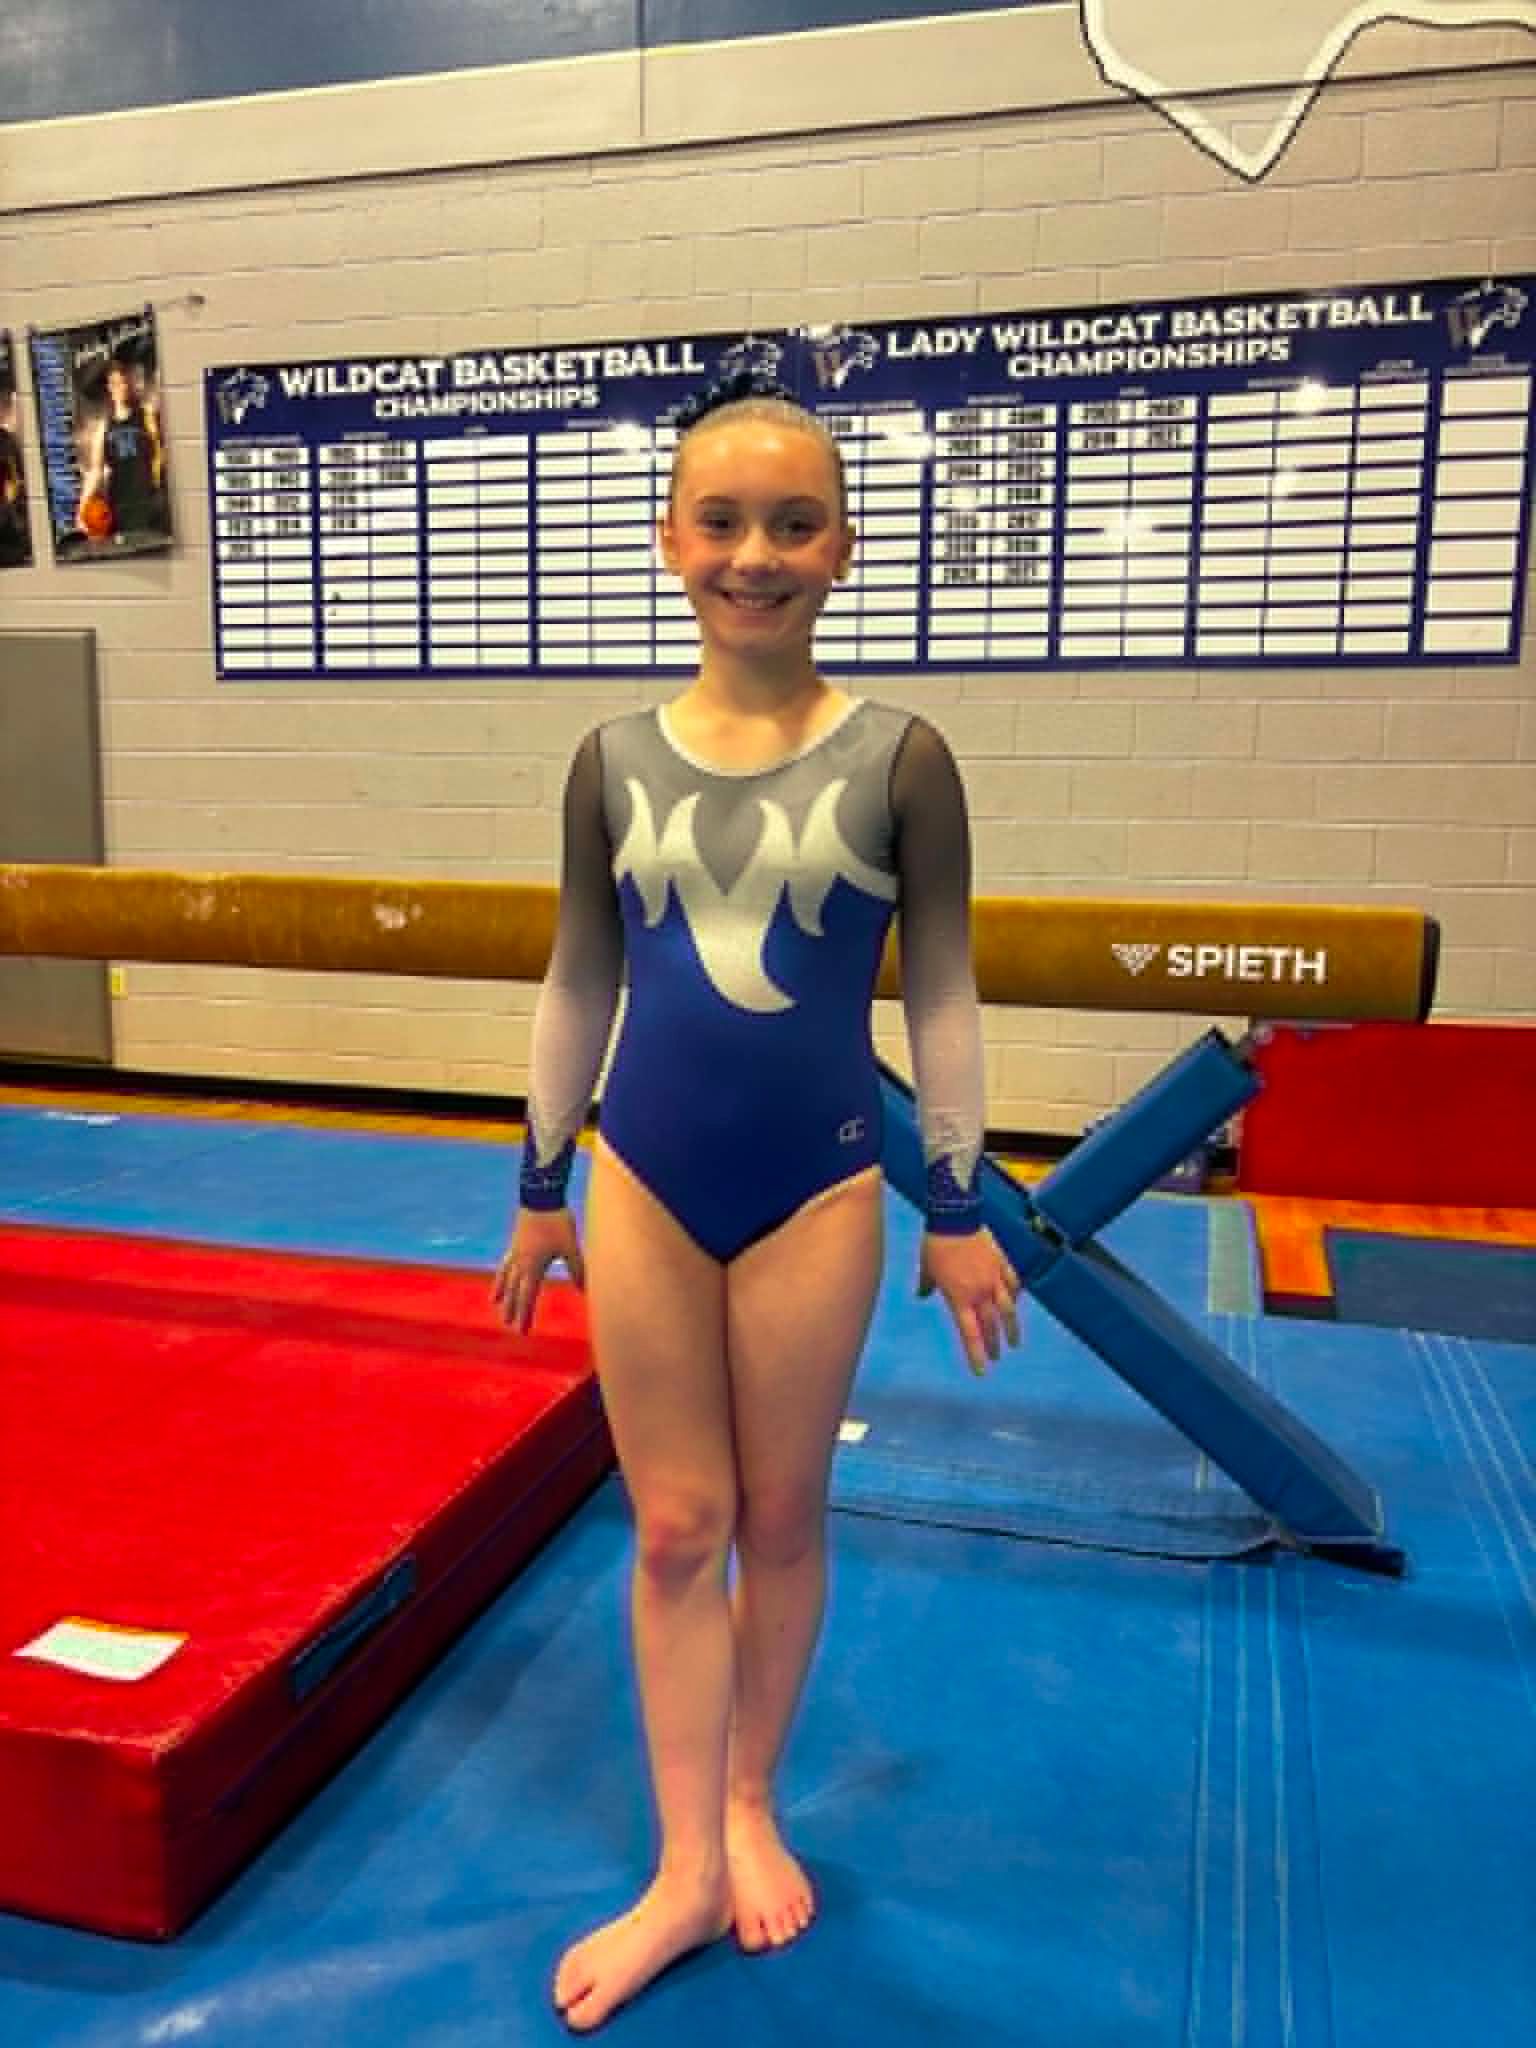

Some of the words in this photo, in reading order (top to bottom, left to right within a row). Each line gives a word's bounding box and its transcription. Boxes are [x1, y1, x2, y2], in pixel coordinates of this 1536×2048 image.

[887, 325, 982, 357] LADY
[990, 312, 1162, 348] WILDCAT
[1171, 294, 1433, 338] BASKETBALL
[279, 359, 446, 399] WILDCAT
[453, 341, 704, 388] BASKETBALL
[1008, 336, 1290, 379] CHAMPIONSHIPS
[374, 384, 599, 418] CHAMPIONSHIPS
[1166, 944, 1328, 983] SPIETH
